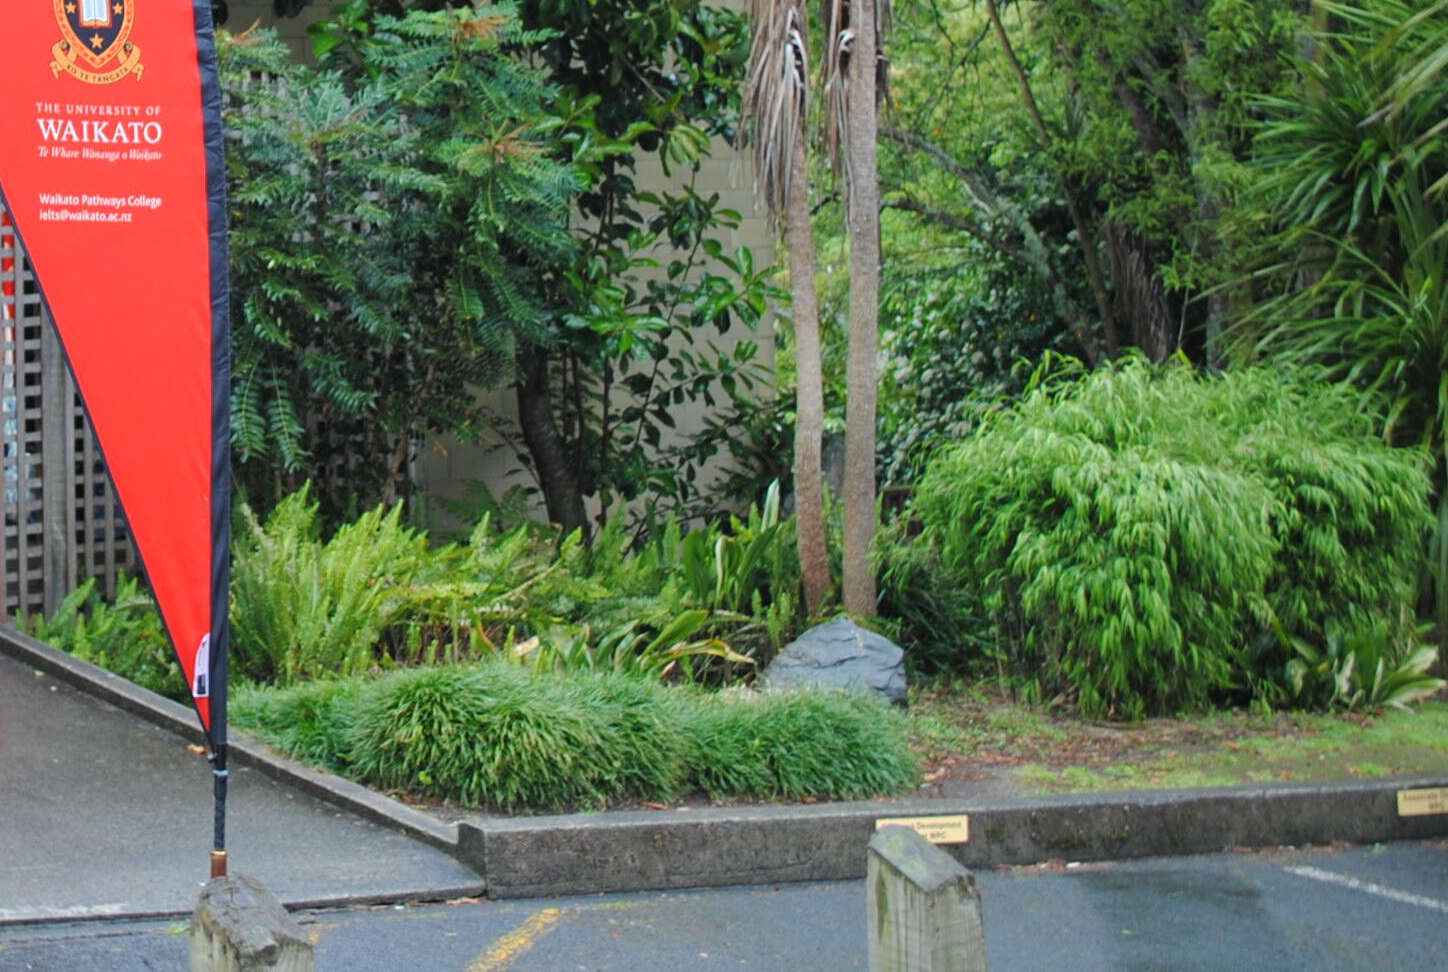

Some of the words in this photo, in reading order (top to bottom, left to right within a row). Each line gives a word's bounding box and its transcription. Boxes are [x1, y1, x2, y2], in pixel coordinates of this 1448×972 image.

[92, 67, 129, 82] TANGATA
[36, 102, 60, 113] THE
[66, 104, 141, 116] UNIVERSITY
[145, 106, 161, 116] OF
[37, 118, 162, 144] WAIKATO
[38, 146, 48, 157] Te
[51, 146, 79, 158] Whare
[121, 151, 128, 159] o
[129, 148, 162, 161] Waikato
[39, 193, 80, 205] Waikato
[81, 194, 126, 209] Pathways
[127, 195, 162, 209] College
[39, 209, 132, 222] ielts@waikato.ac.nz
